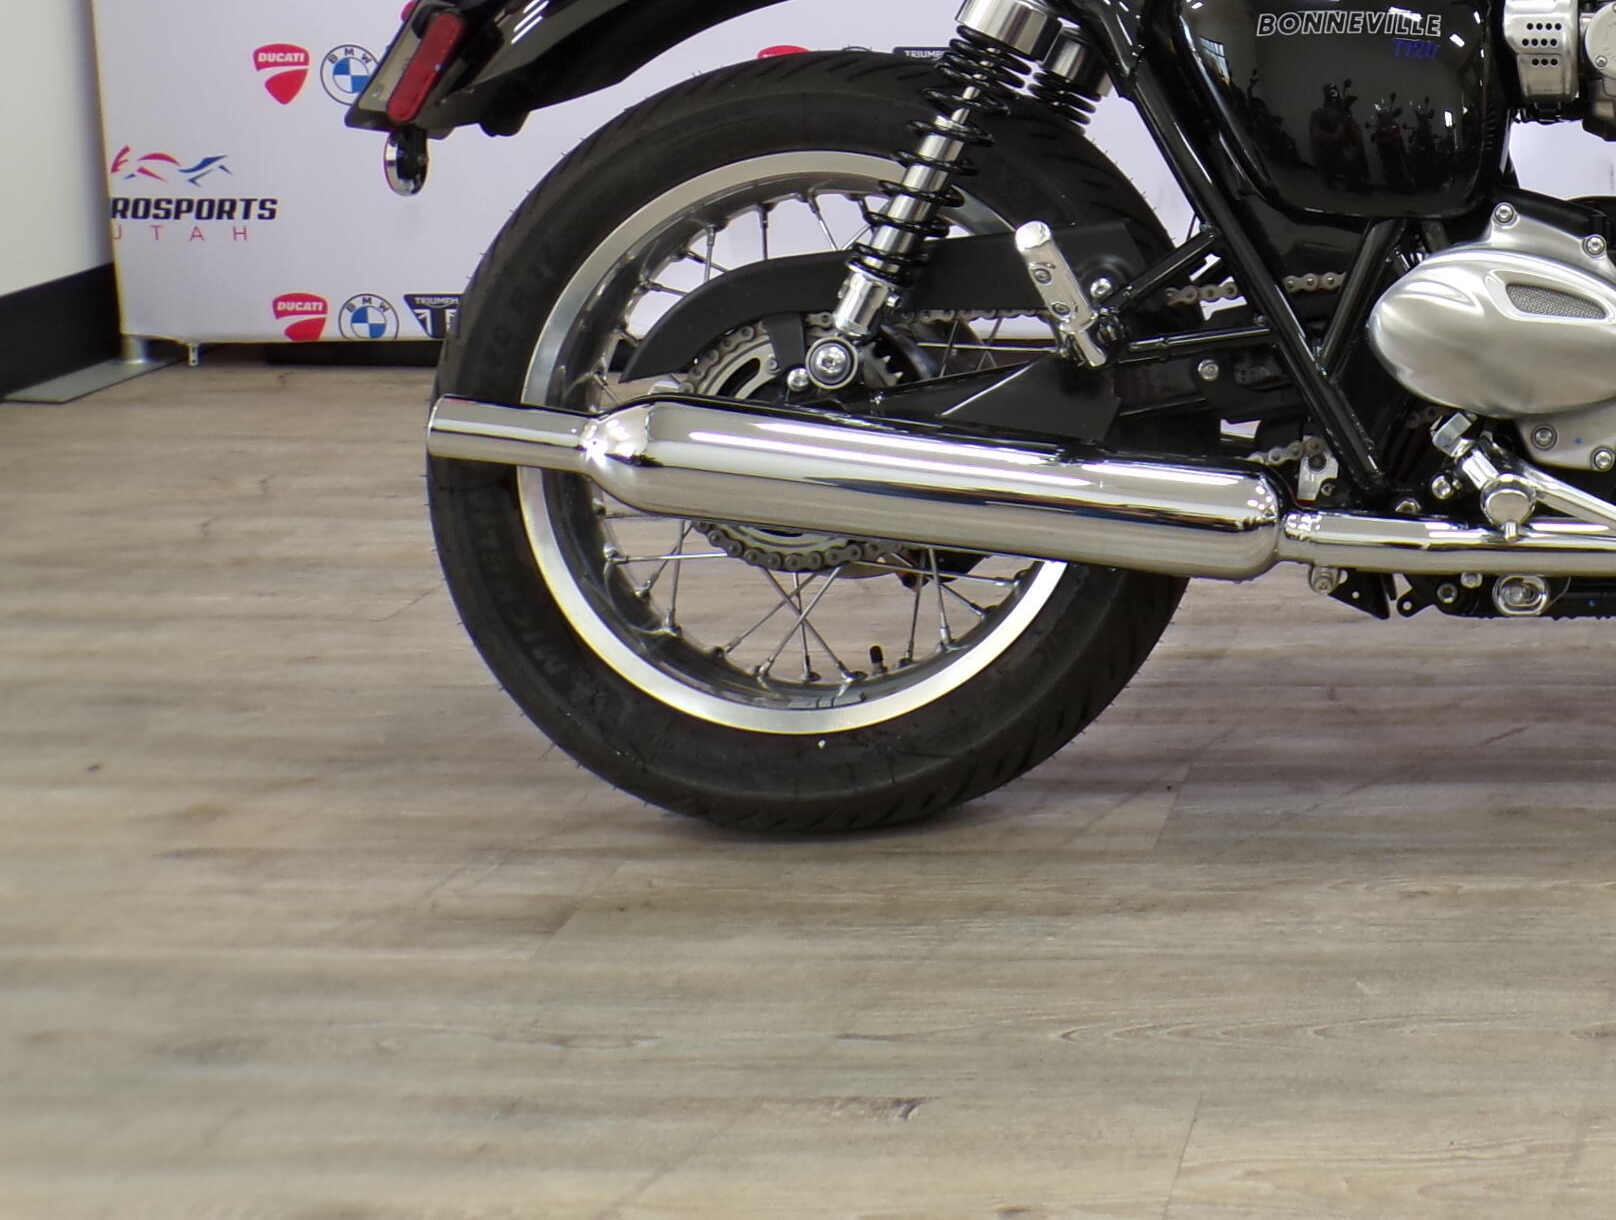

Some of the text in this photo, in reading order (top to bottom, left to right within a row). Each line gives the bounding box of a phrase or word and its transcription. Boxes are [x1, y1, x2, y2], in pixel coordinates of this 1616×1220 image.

[1257, 11, 1441, 37] BONNEVILLE
[329, 49, 372, 64] BMW
[903, 50, 945, 59] TRIUMP
[1391, 39, 1440, 59] T120
[258, 53, 305, 63] DUCATI
[111, 198, 278, 221] ROSPORTS
[277, 301, 323, 311] DUCATI
[346, 297, 389, 313] BMW
